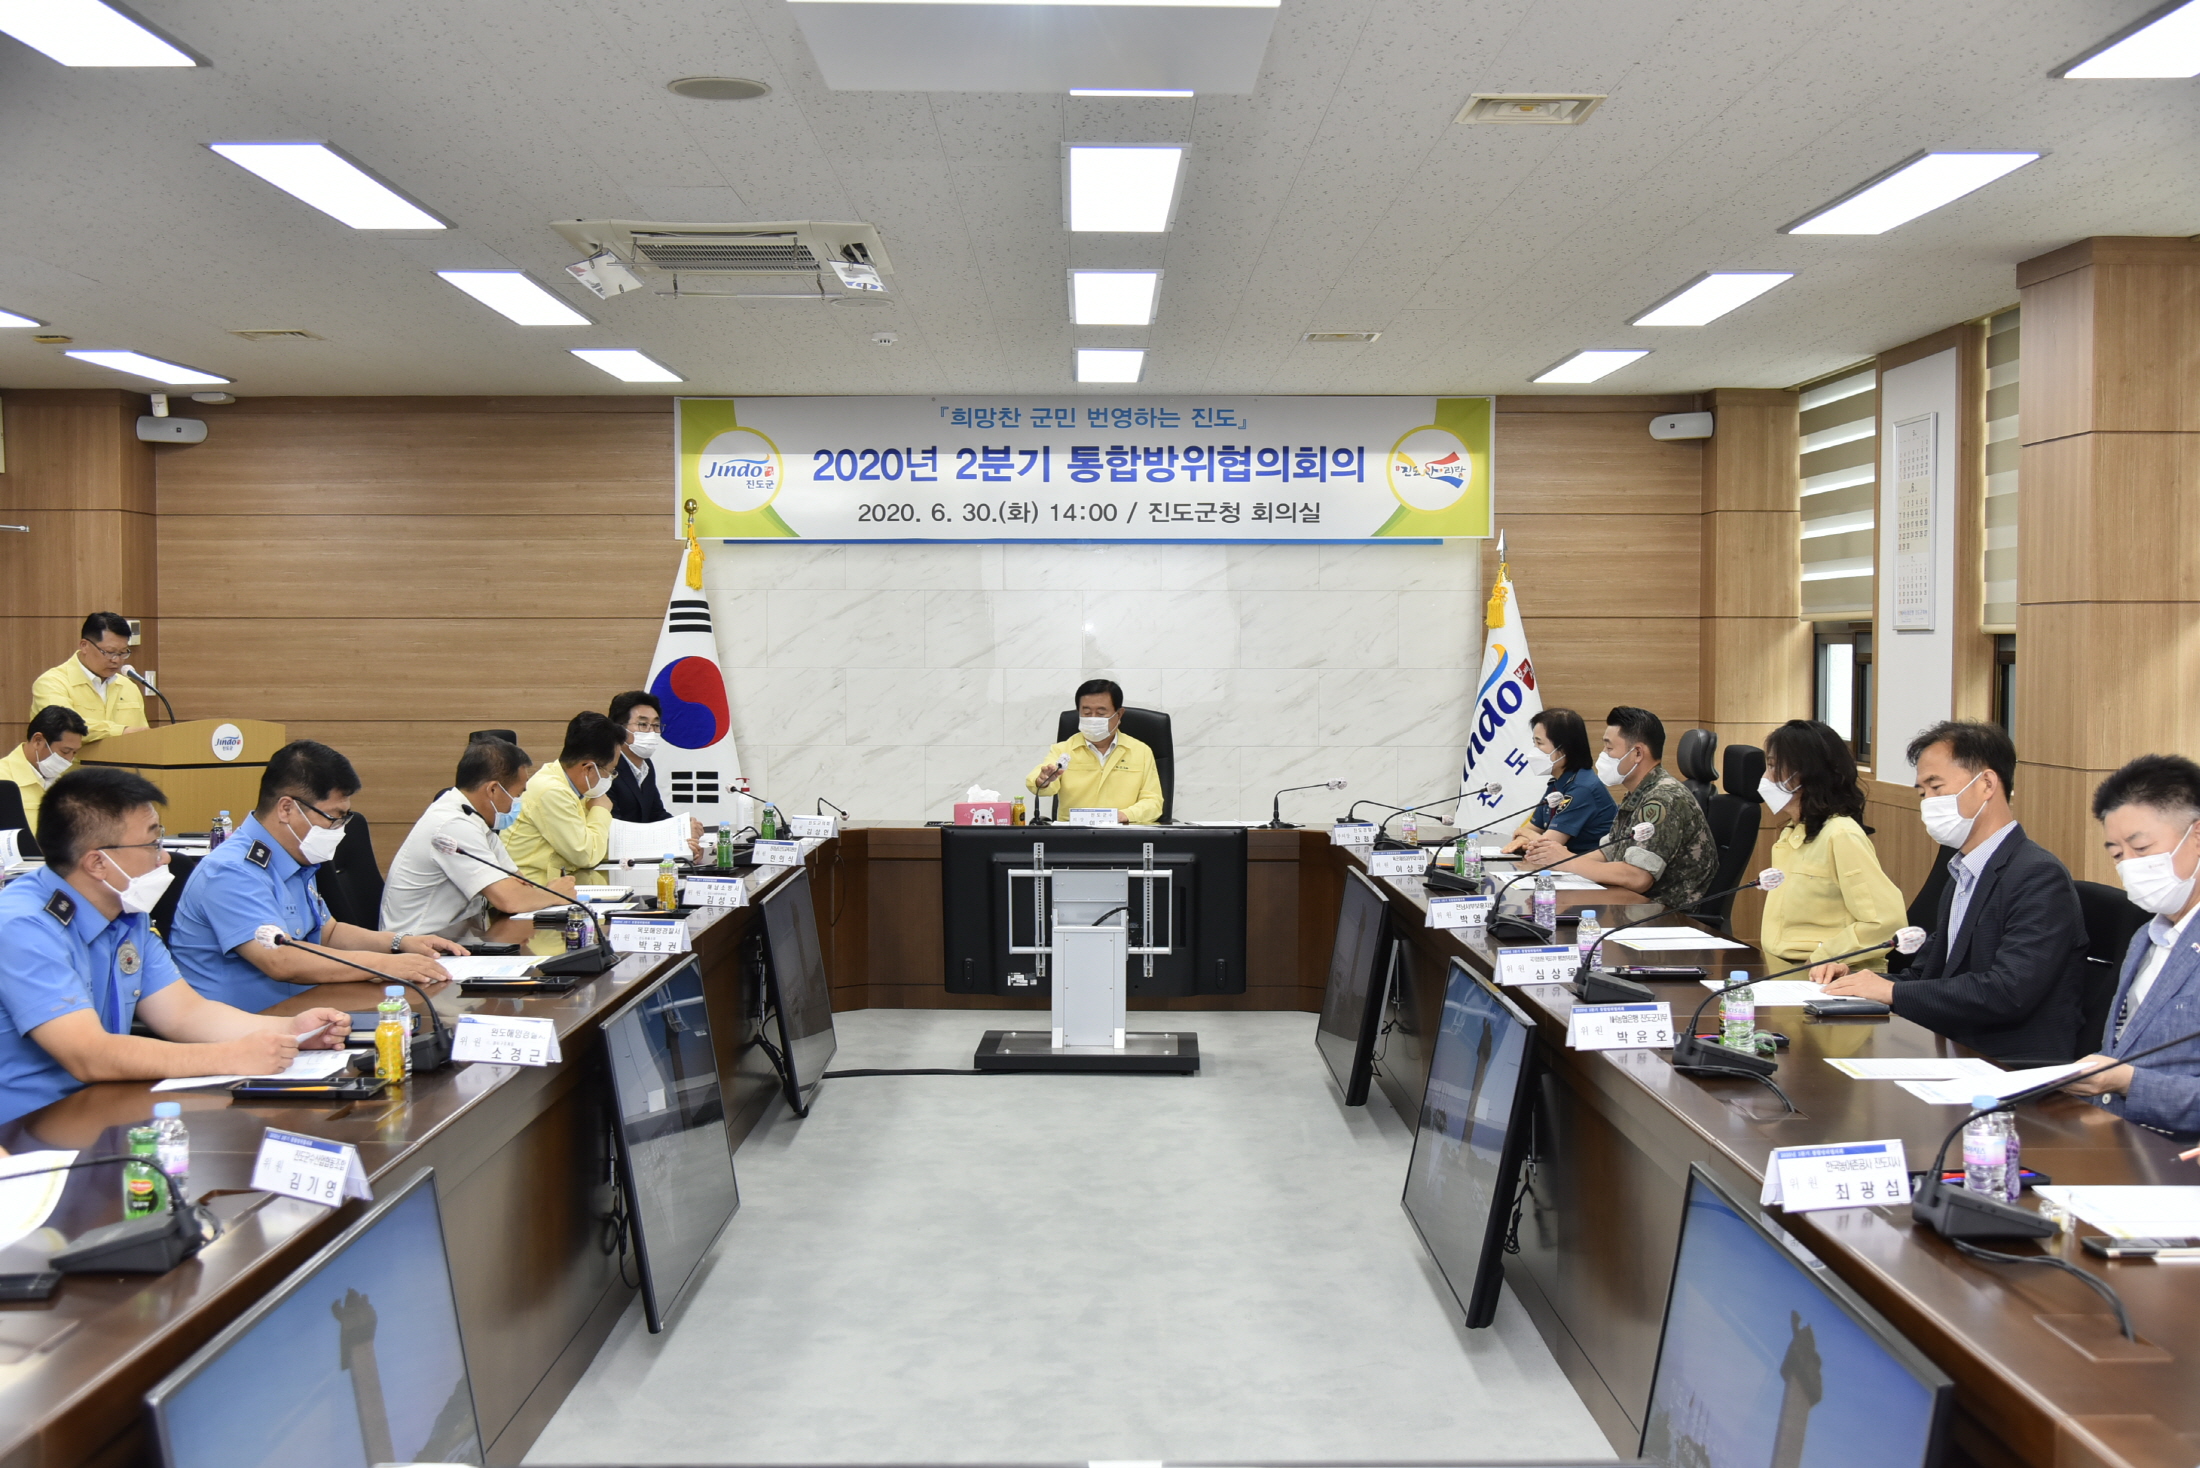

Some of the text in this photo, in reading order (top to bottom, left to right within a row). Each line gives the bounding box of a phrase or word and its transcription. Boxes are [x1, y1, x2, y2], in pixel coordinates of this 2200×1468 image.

[941, 407, 1247, 430] 『희망찬 군민 번영하는 진도』
[704, 462, 763, 478] Jindo
[813, 445, 1365, 484] 2020년 2분기 통합방위협의회의
[746, 480, 774, 489] 진도군
[857, 501, 1321, 525] 2020. 6. 30.(화) 14:00 / 진도군청 회의실
